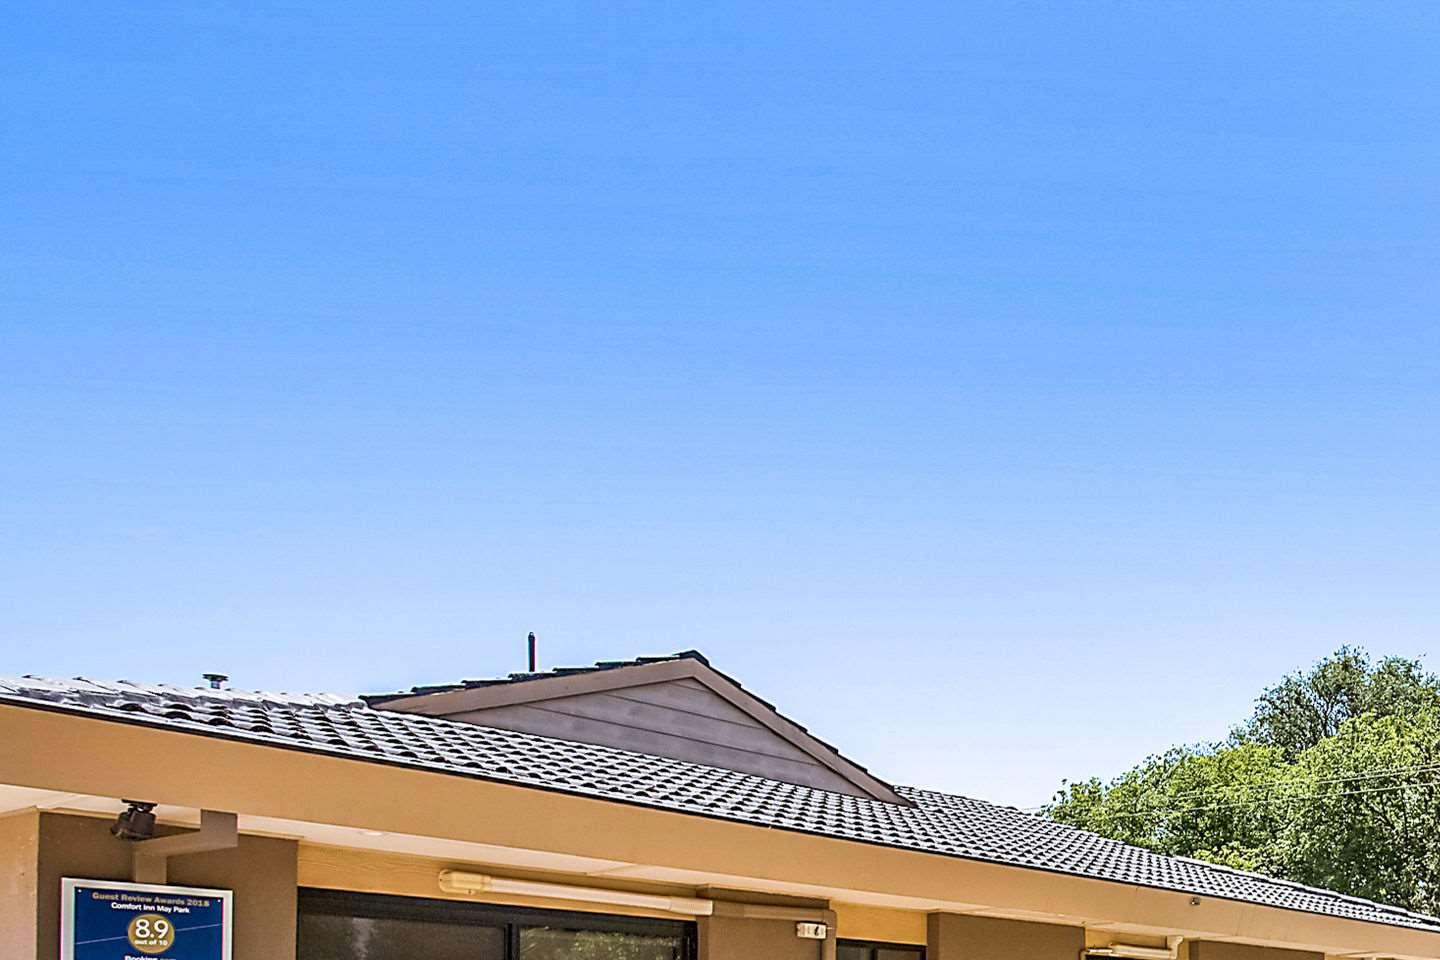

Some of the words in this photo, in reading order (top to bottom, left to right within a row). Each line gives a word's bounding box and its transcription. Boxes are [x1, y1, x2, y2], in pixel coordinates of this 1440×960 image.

[92, 892, 119, 901] Guest
[121, 893, 152, 903] Review
[154, 896, 185, 906] Awards
[111, 902, 142, 911] Comfort
[143, 903, 156, 912] Inn
[157, 905, 172, 914] May
[173, 906, 190, 914] Park
[135, 918, 169, 939] 8.9
